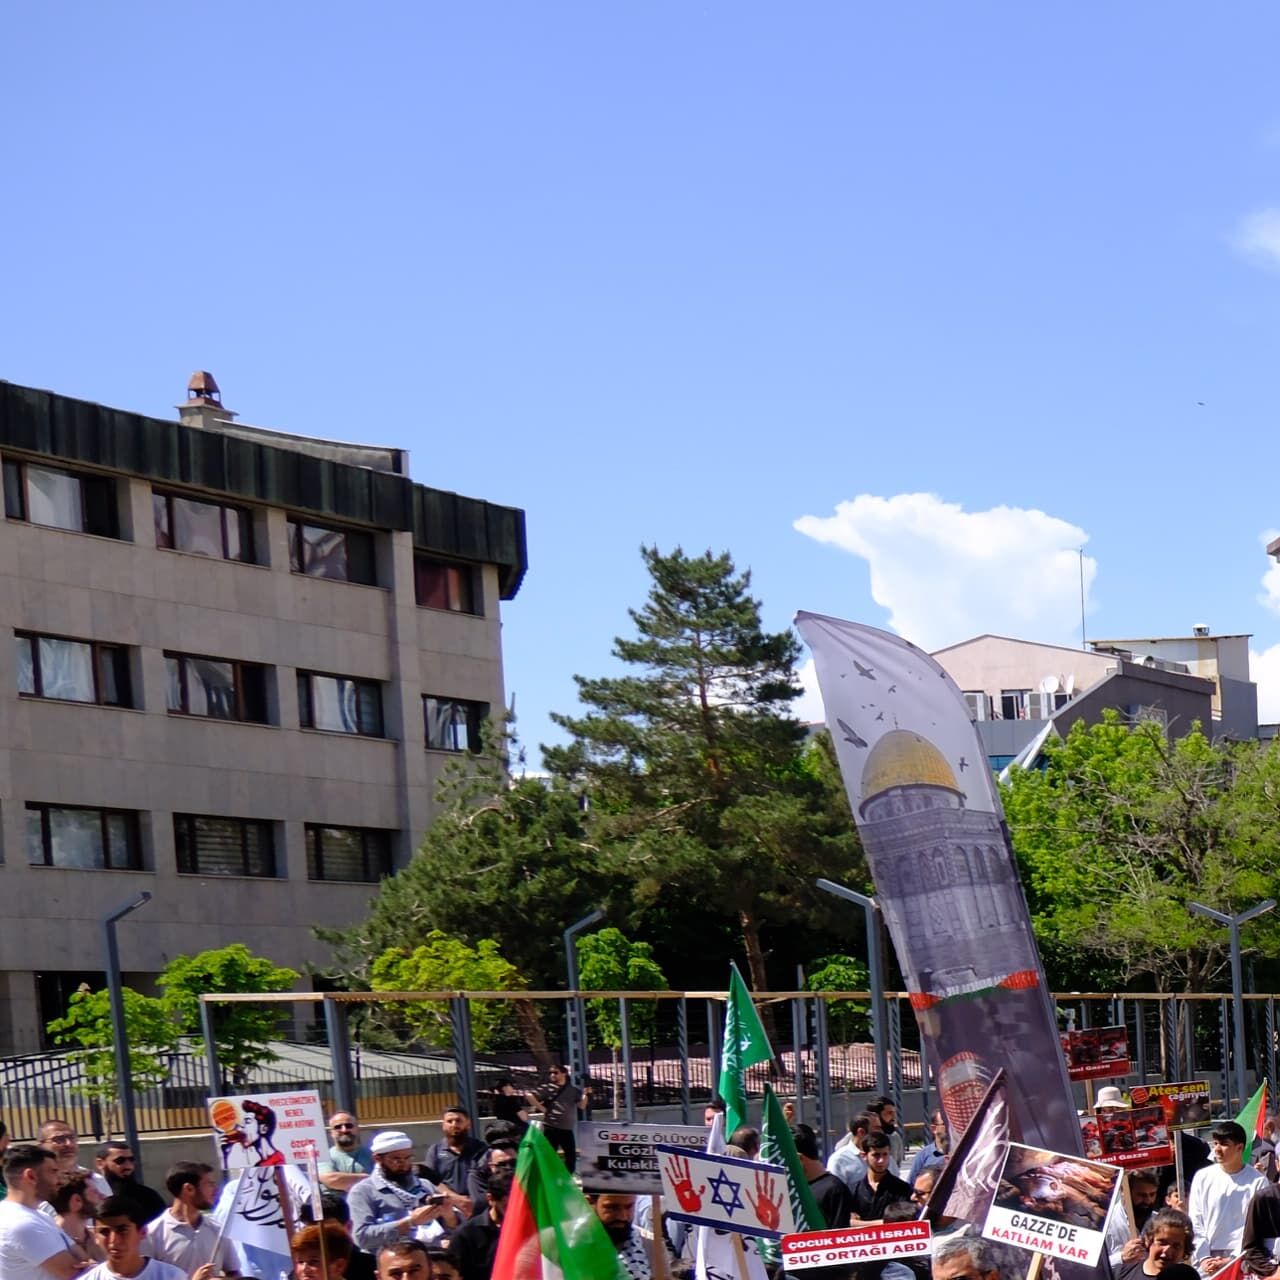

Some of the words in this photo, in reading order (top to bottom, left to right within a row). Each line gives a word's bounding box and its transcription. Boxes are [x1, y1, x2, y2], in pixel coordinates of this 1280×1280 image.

[598, 1130, 649, 1141] Gazze
[788, 1236, 833, 1251] ÇOCUK
[835, 1232, 876, 1244] KATİLİ
[880, 1227, 925, 1239] İSRAİL
[1010, 1214, 1078, 1242] GAZZE'DE
[788, 1254, 821, 1265] SUÇ
[825, 1245, 887, 1260] ORTAĞI
[892, 1242, 927, 1254] ABD
[1058, 1243, 1089, 1259] VAR
